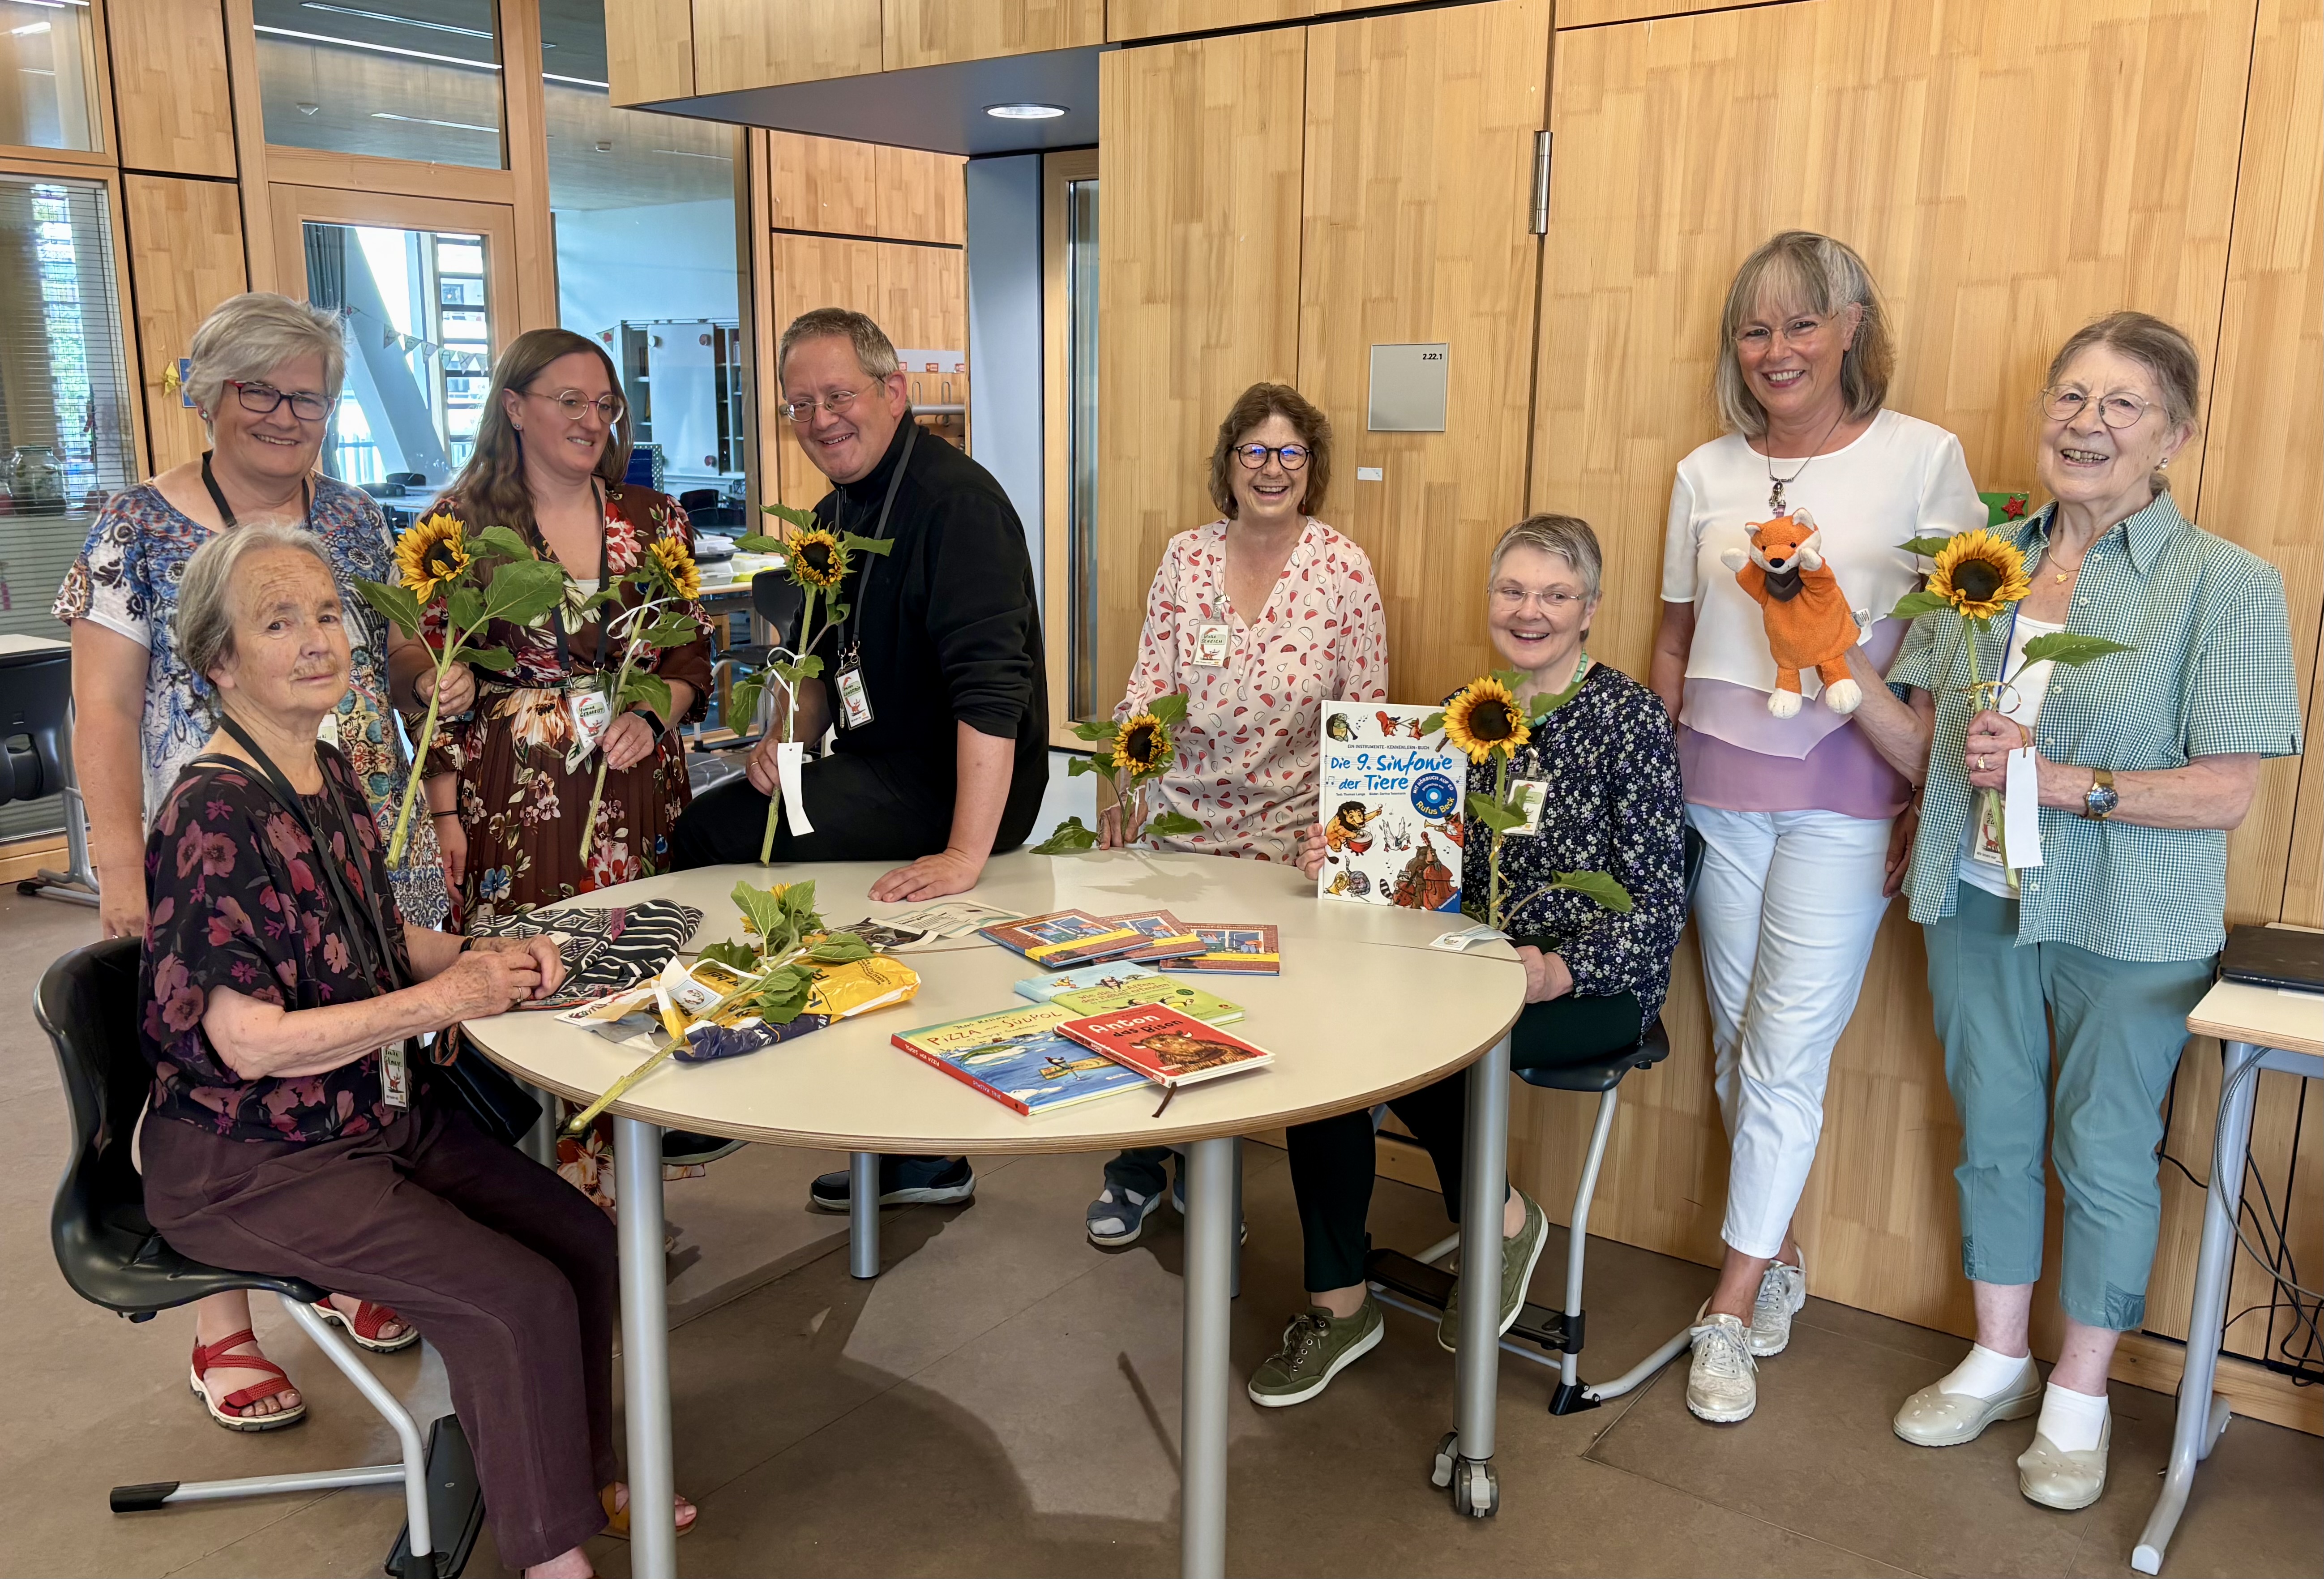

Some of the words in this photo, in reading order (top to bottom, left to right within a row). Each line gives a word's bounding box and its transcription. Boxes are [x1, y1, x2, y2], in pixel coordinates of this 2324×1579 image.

[1331, 757, 1350, 769] Die
[1357, 753, 1371, 770] 9.
[1377, 751, 1452, 775] Sinfonie
[1339, 779, 1361, 790] der
[1364, 775, 1408, 791] Tiere
[1417, 775, 1438, 786] HÖRBUCH
[1416, 800, 1438, 814] Rufus
[1439, 797, 1454, 813] Beck
[1127, 982, 1155, 990] Affen
[1088, 1015, 1160, 1033] Anton
[1113, 1028, 1138, 1037] das
[1140, 1020, 1183, 1033] Bison
